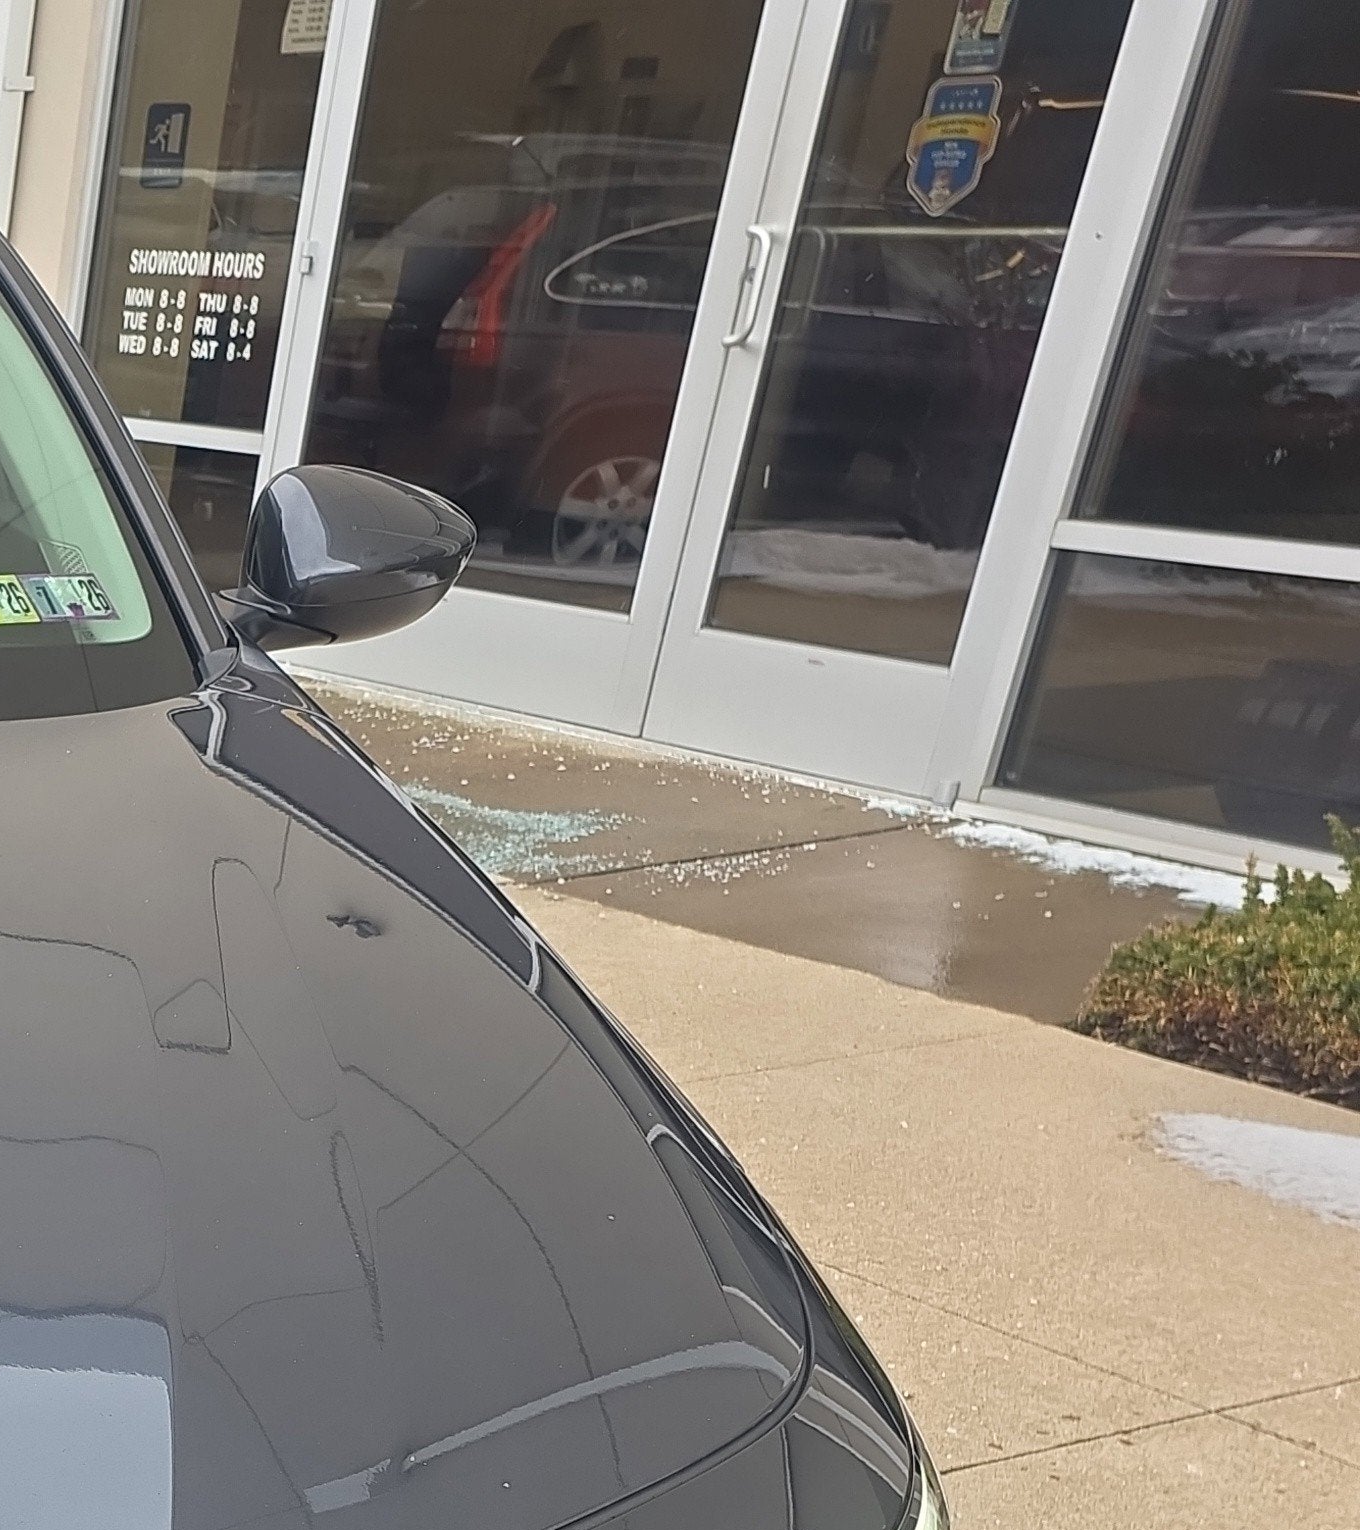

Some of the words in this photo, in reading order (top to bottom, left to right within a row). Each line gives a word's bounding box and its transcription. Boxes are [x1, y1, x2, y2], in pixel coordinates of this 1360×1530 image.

[129, 249, 211, 277] SHOWROOM
[212, 252, 266, 279] HOURS
[124, 287, 155, 308] MON
[158, 288, 187, 310] 8-8
[198, 292, 228, 314] THU
[232, 294, 260, 316] 8-8
[122, 310, 149, 331] TUE
[155, 312, 184, 334] 8-8
[193, 315, 218, 337] FRI
[229, 317, 256, 340] 8-8
[118, 333, 147, 355] WED
[151, 335, 180, 358] 8-8
[190, 339, 220, 361] SAT
[225, 341, 252, 362] 8-4
[77, 578, 111, 614] 26
